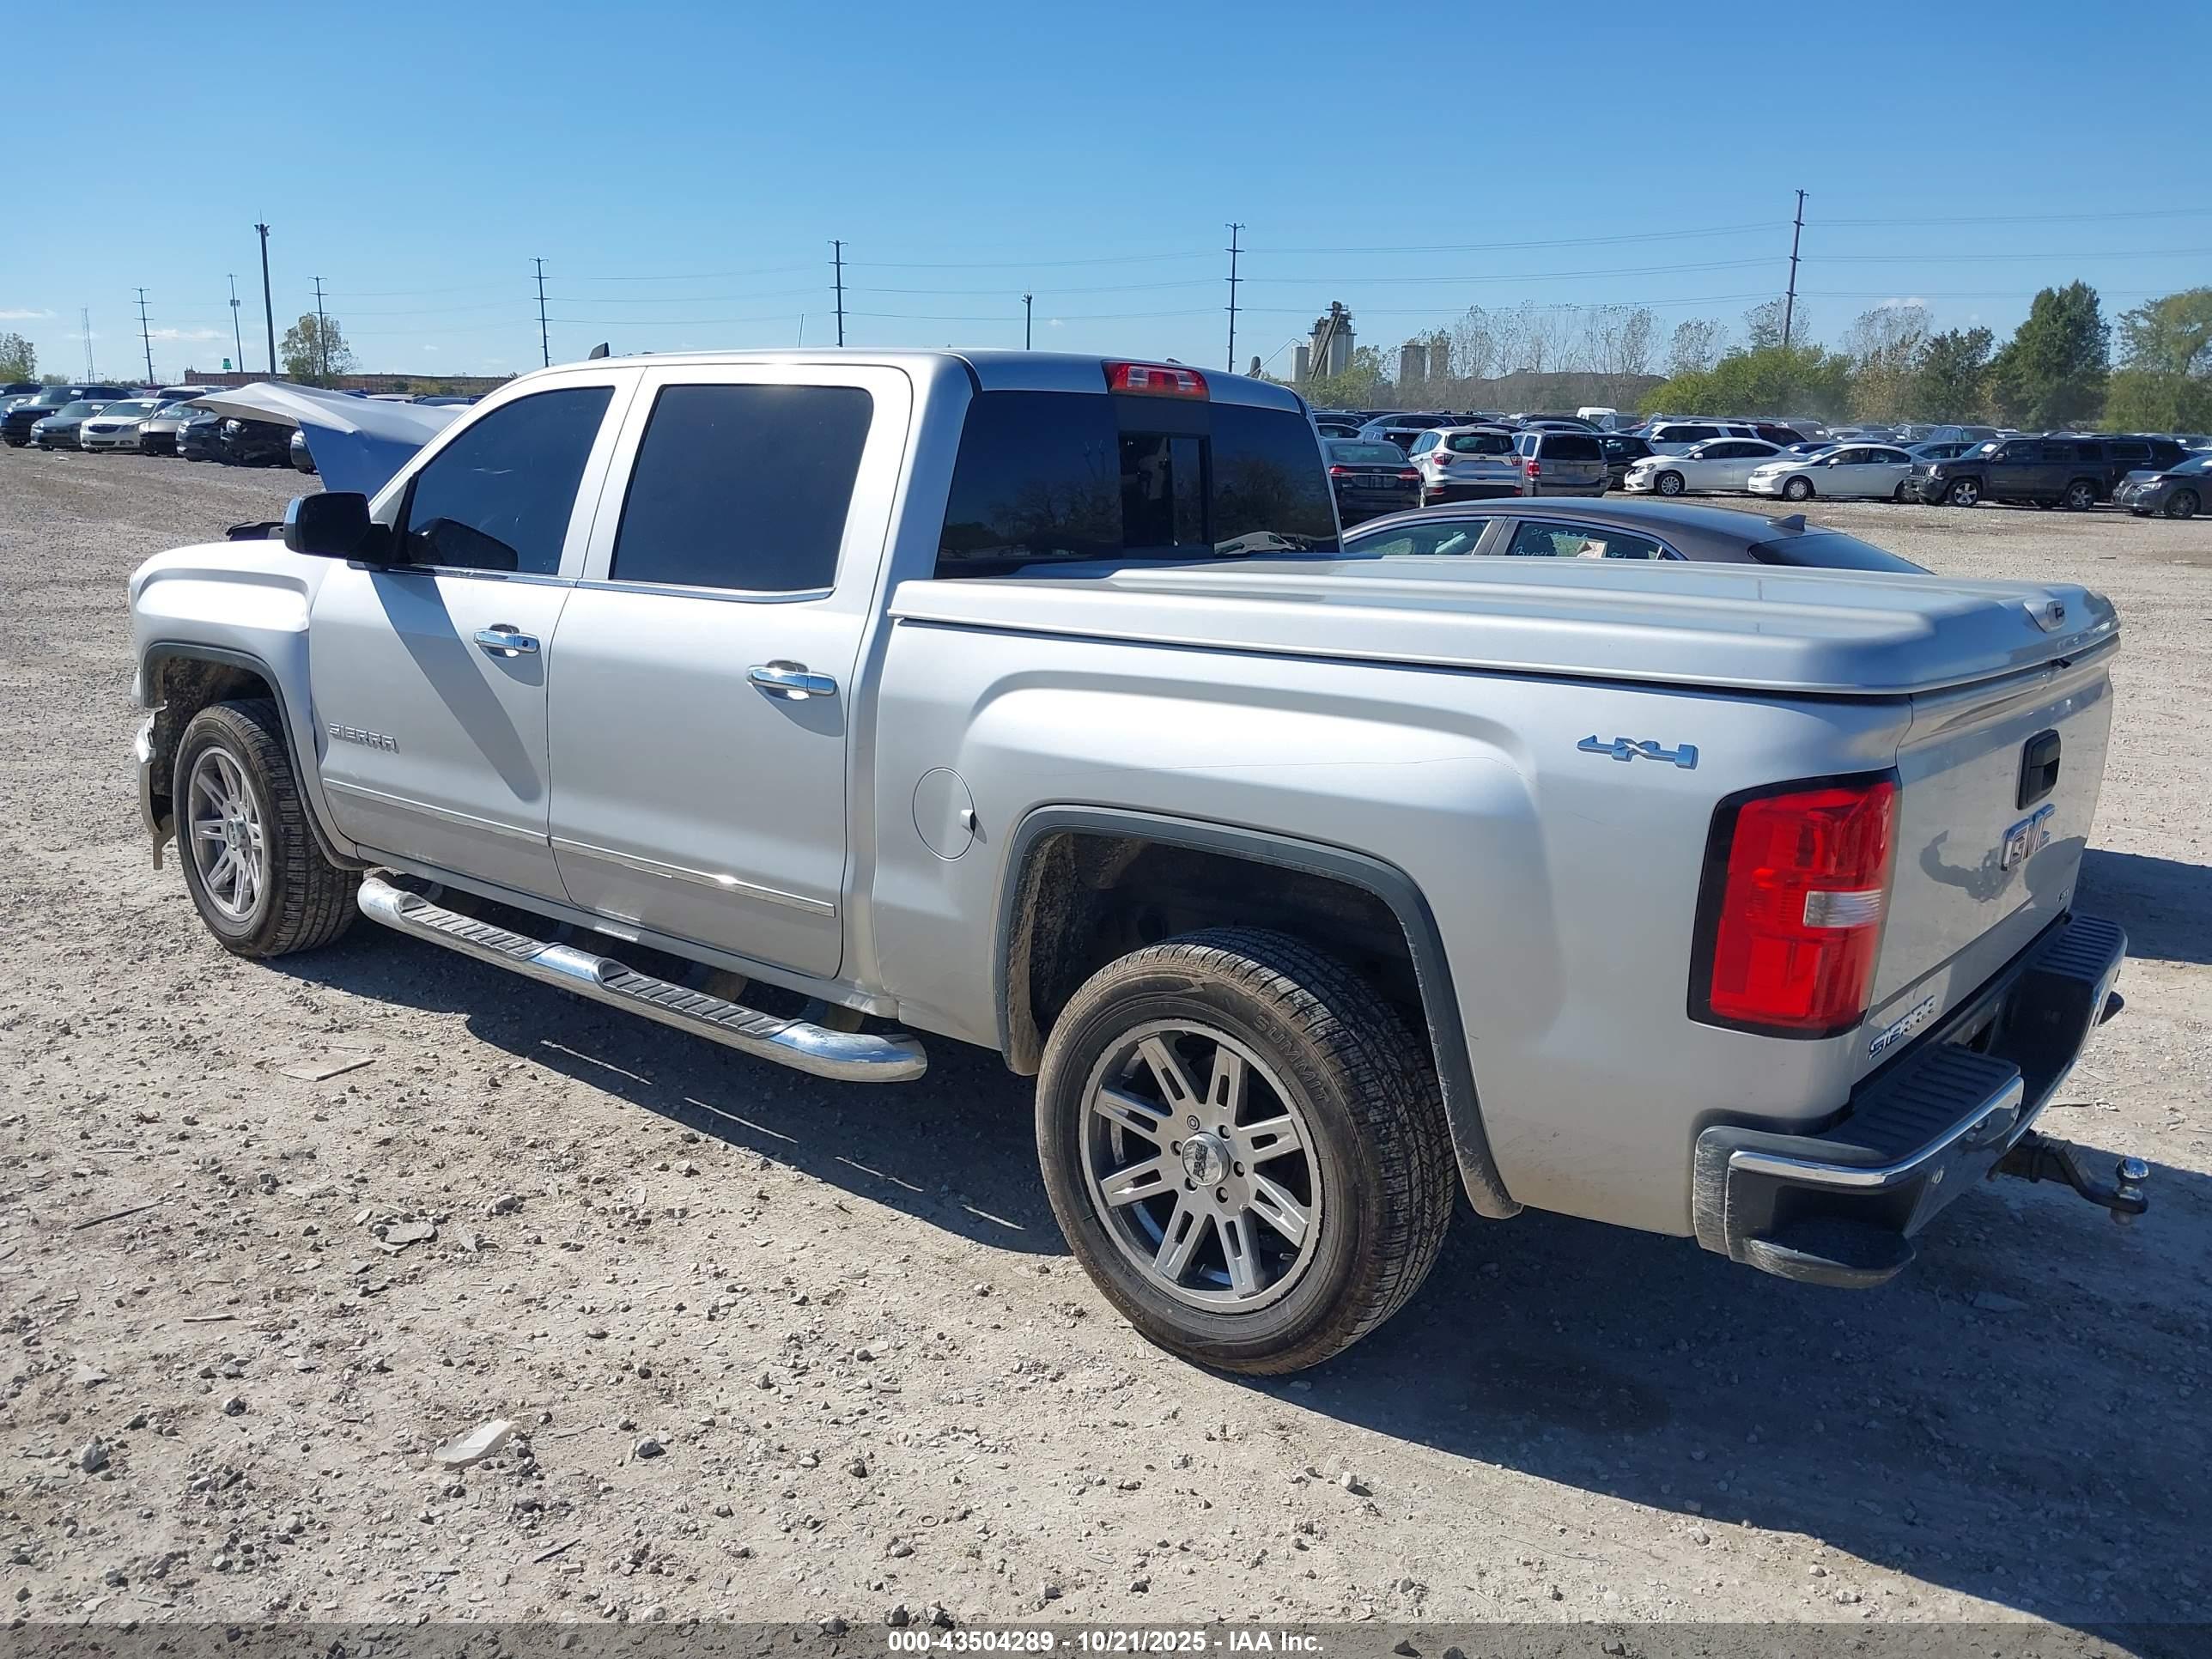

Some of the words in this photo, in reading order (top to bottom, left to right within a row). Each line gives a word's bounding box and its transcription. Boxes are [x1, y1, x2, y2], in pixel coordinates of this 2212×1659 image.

[329, 722, 398, 752] SIERRA
[2001, 804, 2056, 871] GMC
[1255, 1015, 1331, 1103] SUMMIT
[1868, 994, 1936, 1060] SIERRA
